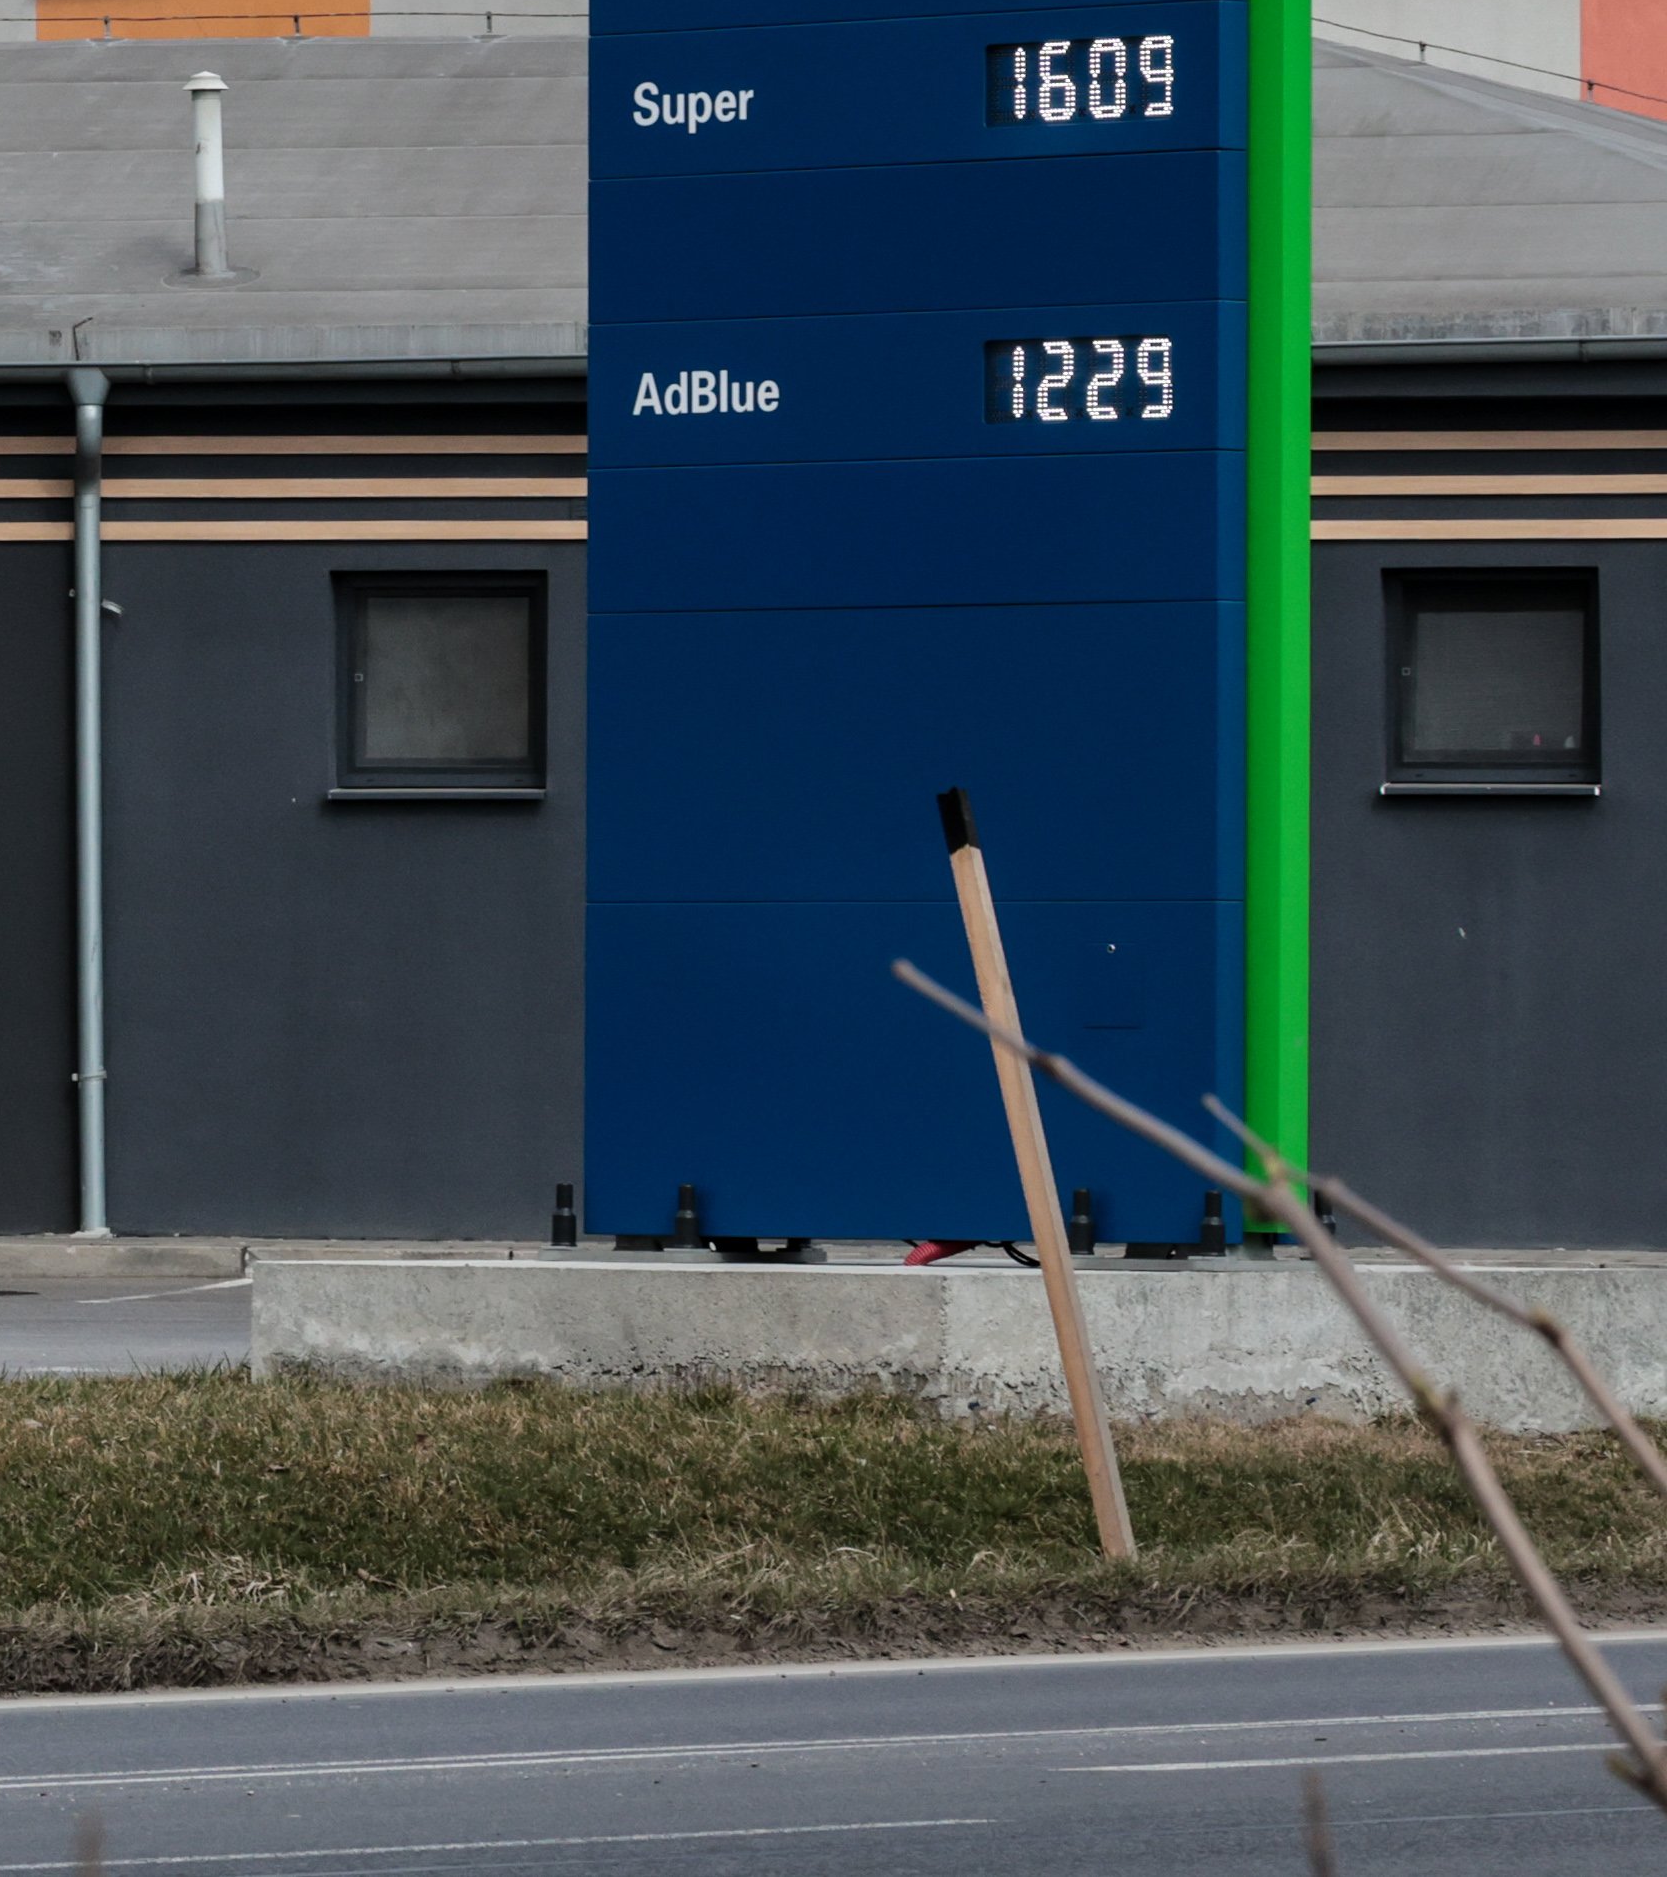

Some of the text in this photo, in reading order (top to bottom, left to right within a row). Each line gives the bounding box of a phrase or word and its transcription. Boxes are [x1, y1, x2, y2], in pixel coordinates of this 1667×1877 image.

[632, 34, 1175, 134] Super 1609
[632, 337, 1175, 422] AdBlue 1229
